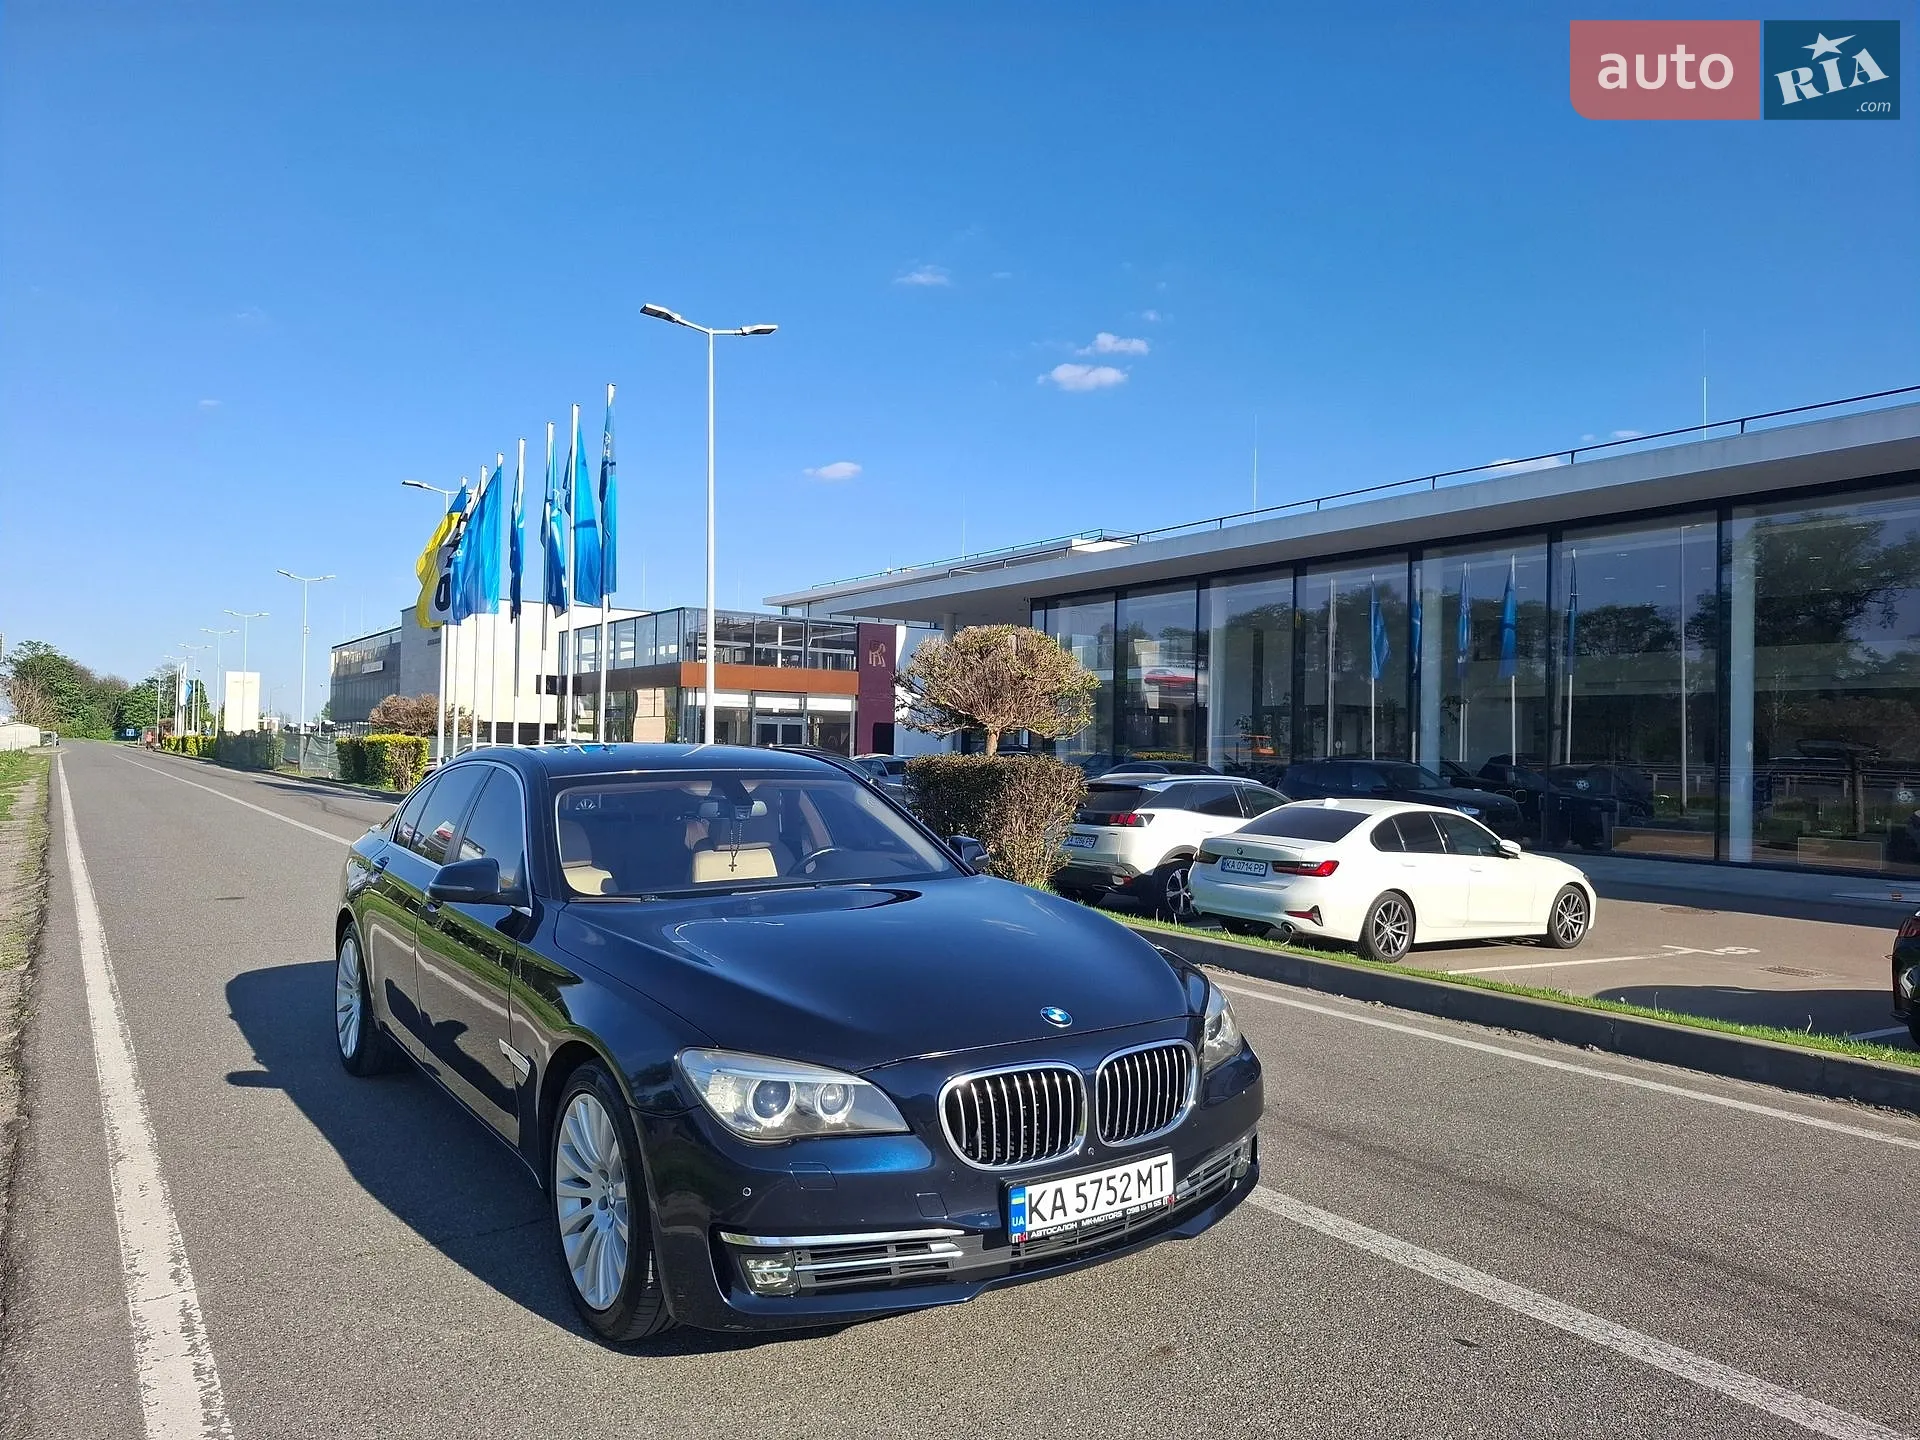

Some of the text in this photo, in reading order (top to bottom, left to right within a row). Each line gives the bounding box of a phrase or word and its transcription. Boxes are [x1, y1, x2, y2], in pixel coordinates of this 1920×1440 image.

[1028, 1161, 1169, 1225] KA 5752 MT
[1012, 1216, 1025, 1227] UA
[1030, 1222, 1078, 1239] АВТОСАЛОН
[1081, 1210, 1123, 1227] MK-MOTORS
